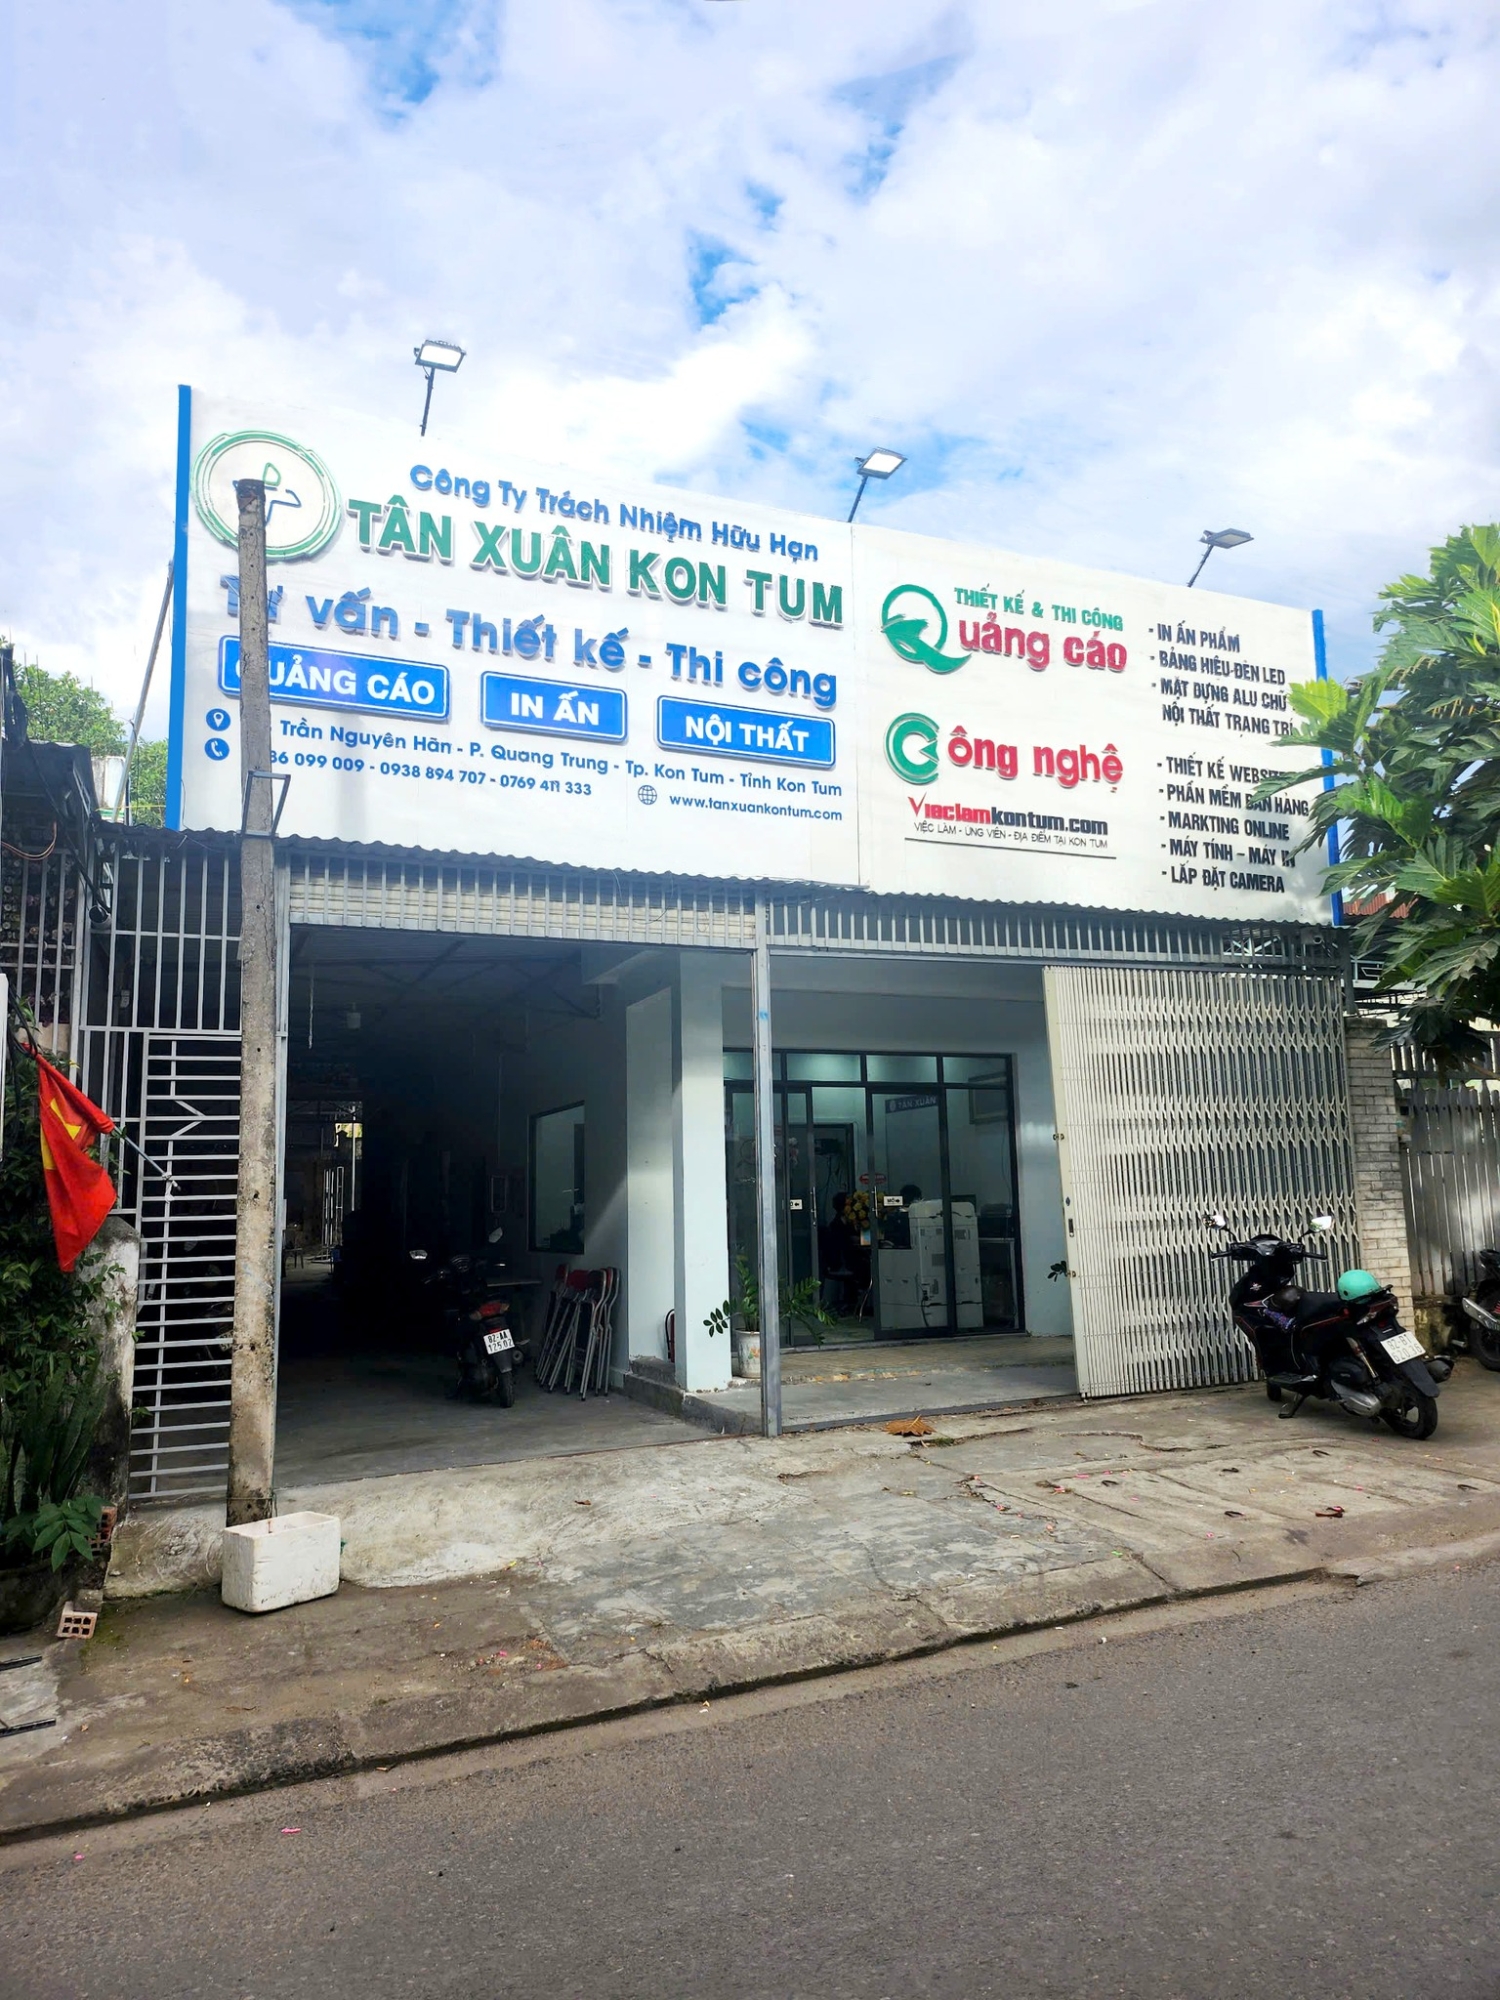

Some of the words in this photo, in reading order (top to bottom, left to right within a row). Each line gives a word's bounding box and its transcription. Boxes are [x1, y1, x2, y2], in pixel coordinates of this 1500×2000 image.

[410, 464, 490, 507] Công
[498, 480, 527, 512] Ty
[536, 487, 609, 524] Trách
[620, 503, 702, 542] Nhiệm
[711, 521, 760, 551] Hữu
[769, 532, 819, 563] Hạn
[346, 494, 454, 566] TÂN
[469, 520, 611, 590] XUÂN
[625, 548, 727, 610] KON
[744, 570, 844, 630] TUM
[954, 584, 998, 610] THIẾT
[1003, 590, 1025, 615] KẾ
[1031, 601, 1044, 617] &
[1052, 604, 1077, 623] THI
[1082, 606, 1124, 632] CÔNG
[305, 587, 399, 640] vấn
[447, 609, 557, 662] Thiết
[573, 627, 630, 671] kế
[666, 643, 724, 686] Thi
[737, 657, 837, 708] công
[1063, 631, 1128, 672] cáo
[1157, 623, 1172, 642] IN
[1176, 620, 1196, 646] ẤN
[1200, 626, 1240, 653] PHẨM
[236, 654, 357, 696] UẢNG
[367, 671, 435, 705] CÁO
[1159, 647, 1197, 672] BẢNG
[1263, 667, 1285, 685] LED
[510, 692, 543, 719] IN
[553, 690, 600, 726] ẤN
[1160, 676, 1188, 700] MẶT
[1233, 688, 1257, 707] ALU
[1262, 689, 1287, 712] CHỮ
[685, 713, 732, 745] NỘI
[739, 720, 810, 753] THẤT
[1162, 702, 1184, 727] NỘI
[1189, 704, 1220, 729] THẤT
[280, 717, 323, 740] Trần
[330, 725, 406, 749] Nguyên
[413, 735, 452, 756] Hãn
[469, 742, 484, 758] P.
[491, 744, 554, 768] Quang
[561, 752, 608, 774] Trung
[626, 760, 648, 779] Tp.
[655, 764, 685, 780] Kon
[692, 768, 724, 785] Tum
[740, 771, 772, 790] Tỉnh
[777, 777, 806, 794] Kon
[811, 781, 842, 797] Tum
[295, 753, 327, 768] 099
[333, 757, 364, 772] 009
[380, 762, 420, 778] 0938
[425, 767, 454, 781] 894
[459, 770, 486, 785] 707
[500, 774, 536, 790] 0769
[540, 779, 560, 792] 411
[565, 781, 592, 796] 333
[1033, 743, 1124, 793] nghệ
[1166, 752, 1203, 777] THIẾT
[1208, 756, 1224, 779] KẾ
[669, 794, 843, 821] www.tanxuankontum.com
[1209, 784, 1242, 808] MỀM
[1275, 792, 1309, 816] HÀNG
[914, 820, 935, 833] VIỆC
[937, 822, 956, 835] LÀM
[986, 827, 1006, 840] VIÊN
[1014, 831, 1028, 843] ĐỊA
[1053, 835, 1066, 847] TẠI
[1069, 836, 1087, 848] KON
[1090, 839, 1107, 850] TUM
[1168, 811, 1239, 834] MARKTING
[1244, 820, 1290, 841] ONLINE
[1169, 836, 1198, 857] MÁY
[1203, 838, 1233, 861] TÍNH
[1249, 843, 1277, 865] MÁY
[1171, 860, 1198, 884] LẮP
[1202, 866, 1226, 891] ĐẶT
[1229, 873, 1285, 893] CAMERA
